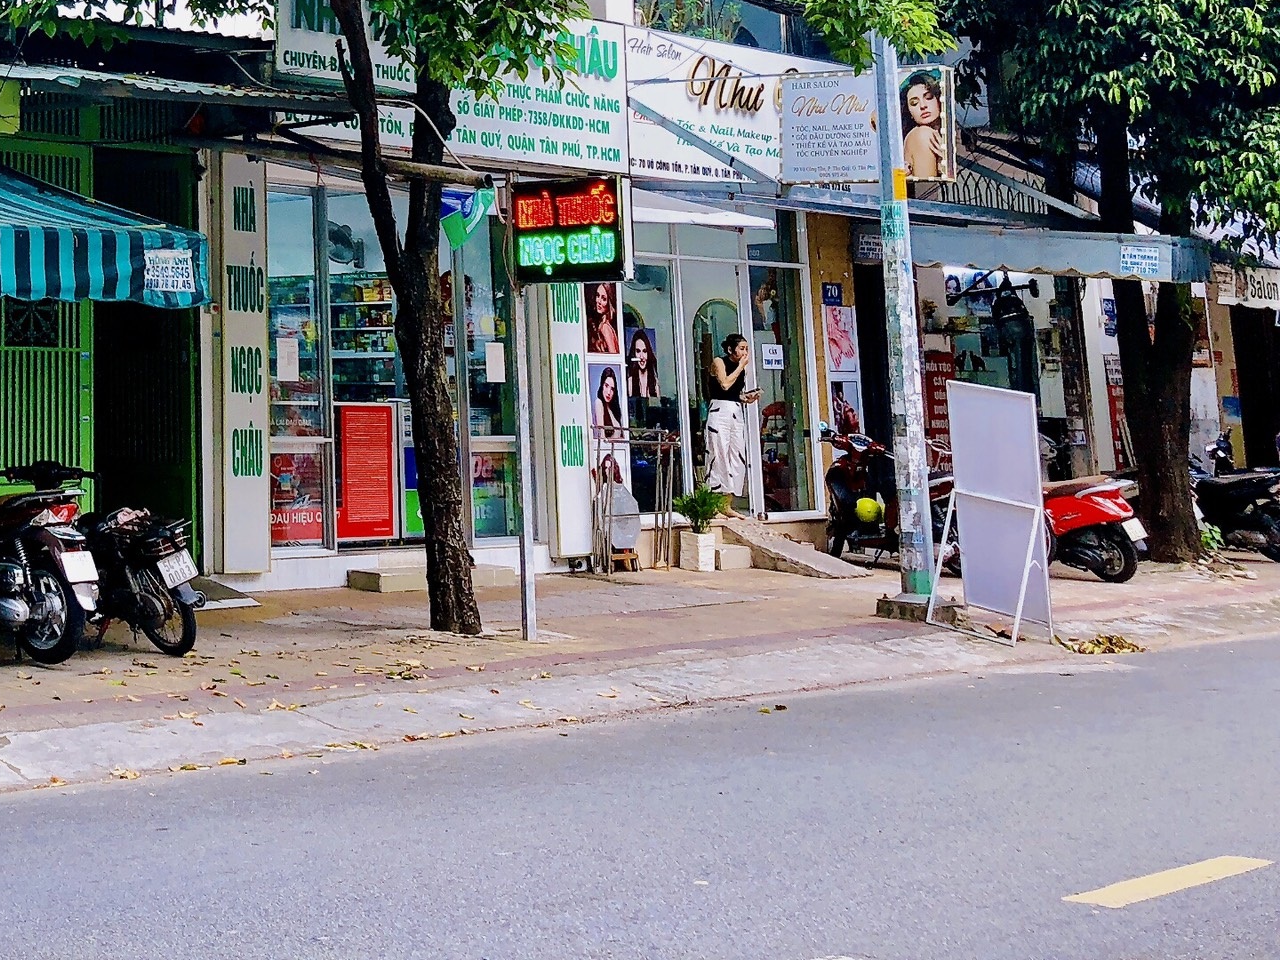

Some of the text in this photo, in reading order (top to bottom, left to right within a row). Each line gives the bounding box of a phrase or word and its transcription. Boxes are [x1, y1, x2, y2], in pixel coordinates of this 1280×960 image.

[283, 50, 326, 71] CHUYÊN
[627, 37, 682, 61] Hair Salon
[688, 55, 765, 112] Như
[792, 80, 839, 90] HAIR SALON
[457, 94, 469, 115] SỐ
[474, 98, 495, 119] GIẤY
[507, 83, 531, 104] THỰC
[535, 83, 562, 105] PHẨM
[593, 94, 620, 113] NĂNG
[791, 93, 869, 117] Như Như
[832, 123, 852, 131] MAKE
[852, 131, 870, 139] SINH
[456, 125, 476, 145] TÂN
[508, 133, 535, 155] QUẬN
[539, 137, 559, 155] TÂN
[726, 141, 740, 153] Và
[745, 144, 763, 157] Tạo
[810, 148, 839, 157] CHUYÊN
[828, 139, 838, 148] VÀ
[233, 180, 256, 232] NHÀ
[518, 184, 614, 228] NHÀ THUỐC
[518, 226, 615, 275] NGỌC CHÂU
[226, 251, 264, 313] THUỐC
[826, 285, 838, 297] 70
[1250, 275, 1279, 300] Salon
[230, 345, 262, 403] NGỌC
[556, 353, 581, 402] NGỌC
[232, 420, 263, 477] CHÂU
[560, 418, 584, 468] CHÂU
[167, 564, 193, 586] 0083
